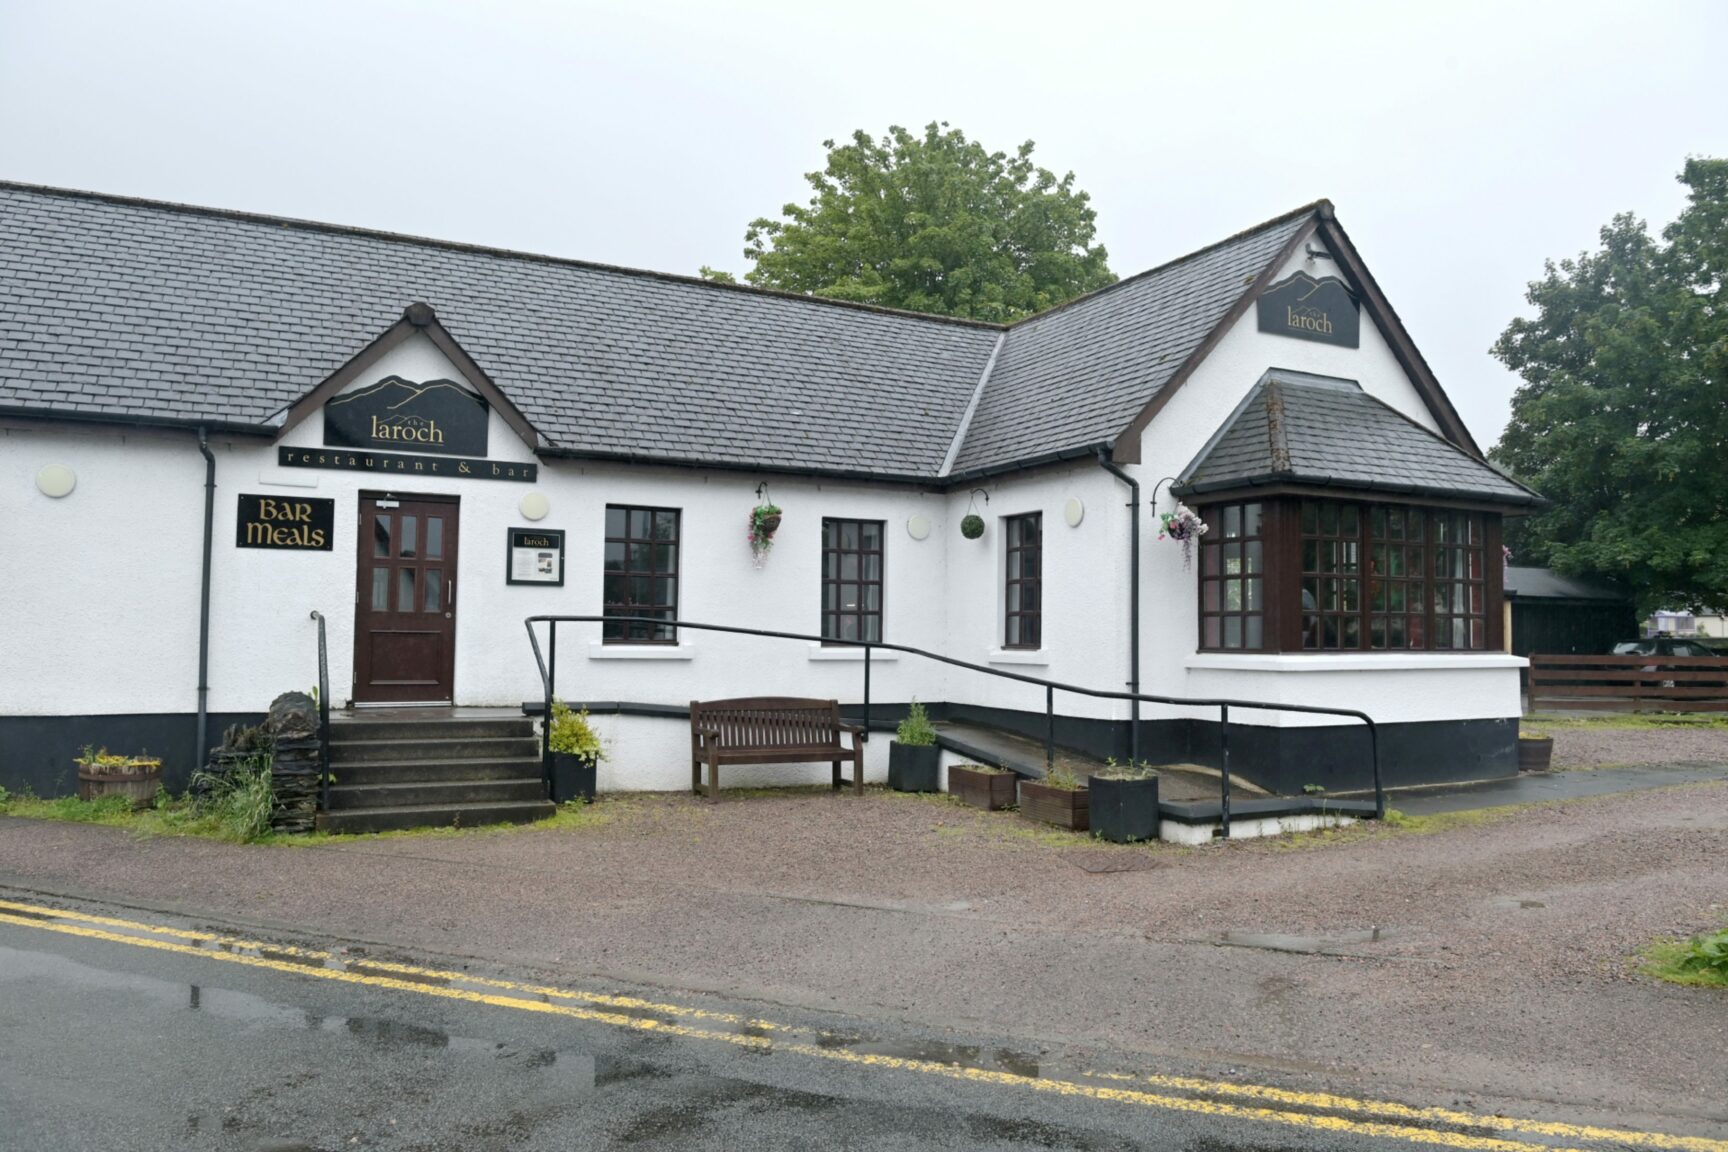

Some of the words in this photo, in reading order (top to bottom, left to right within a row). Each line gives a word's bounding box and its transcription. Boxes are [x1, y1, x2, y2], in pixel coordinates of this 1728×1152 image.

[1288, 305, 1332, 333] laroch
[371, 415, 444, 442] laroch
[287, 453, 438, 471] restaurant
[458, 461, 471, 473] &
[492, 464, 529, 477] bar
[524, 536, 549, 546] laroch
